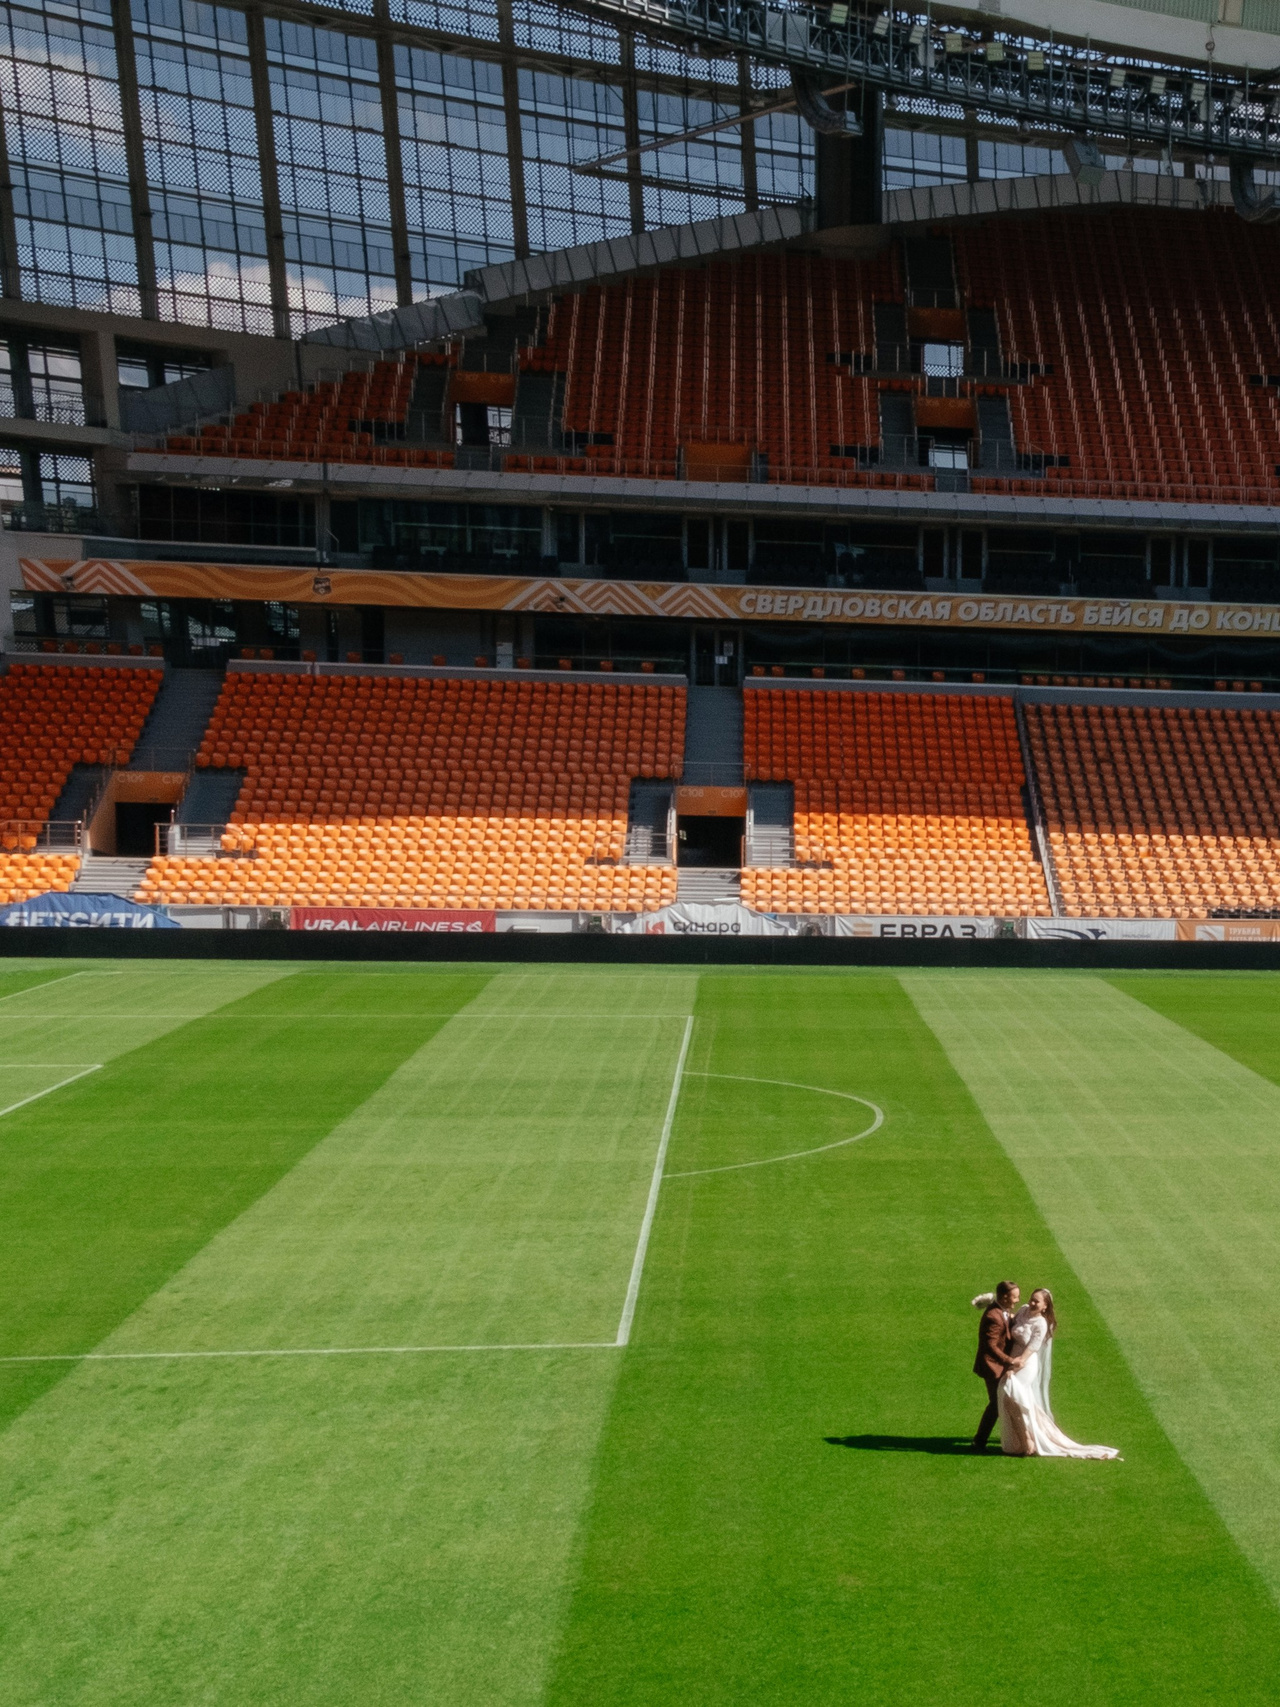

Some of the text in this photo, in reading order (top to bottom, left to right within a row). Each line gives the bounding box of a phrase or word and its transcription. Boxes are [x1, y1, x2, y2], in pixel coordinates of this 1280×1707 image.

[739, 593, 952, 621] СВЕРДЛОВСКАЯ
[957, 601, 1077, 625] ОБЛАСТЬ
[1083, 602, 1165, 628] БЕЙСЯ
[1169, 609, 1211, 633] ДО
[672, 920, 741, 934] синара
